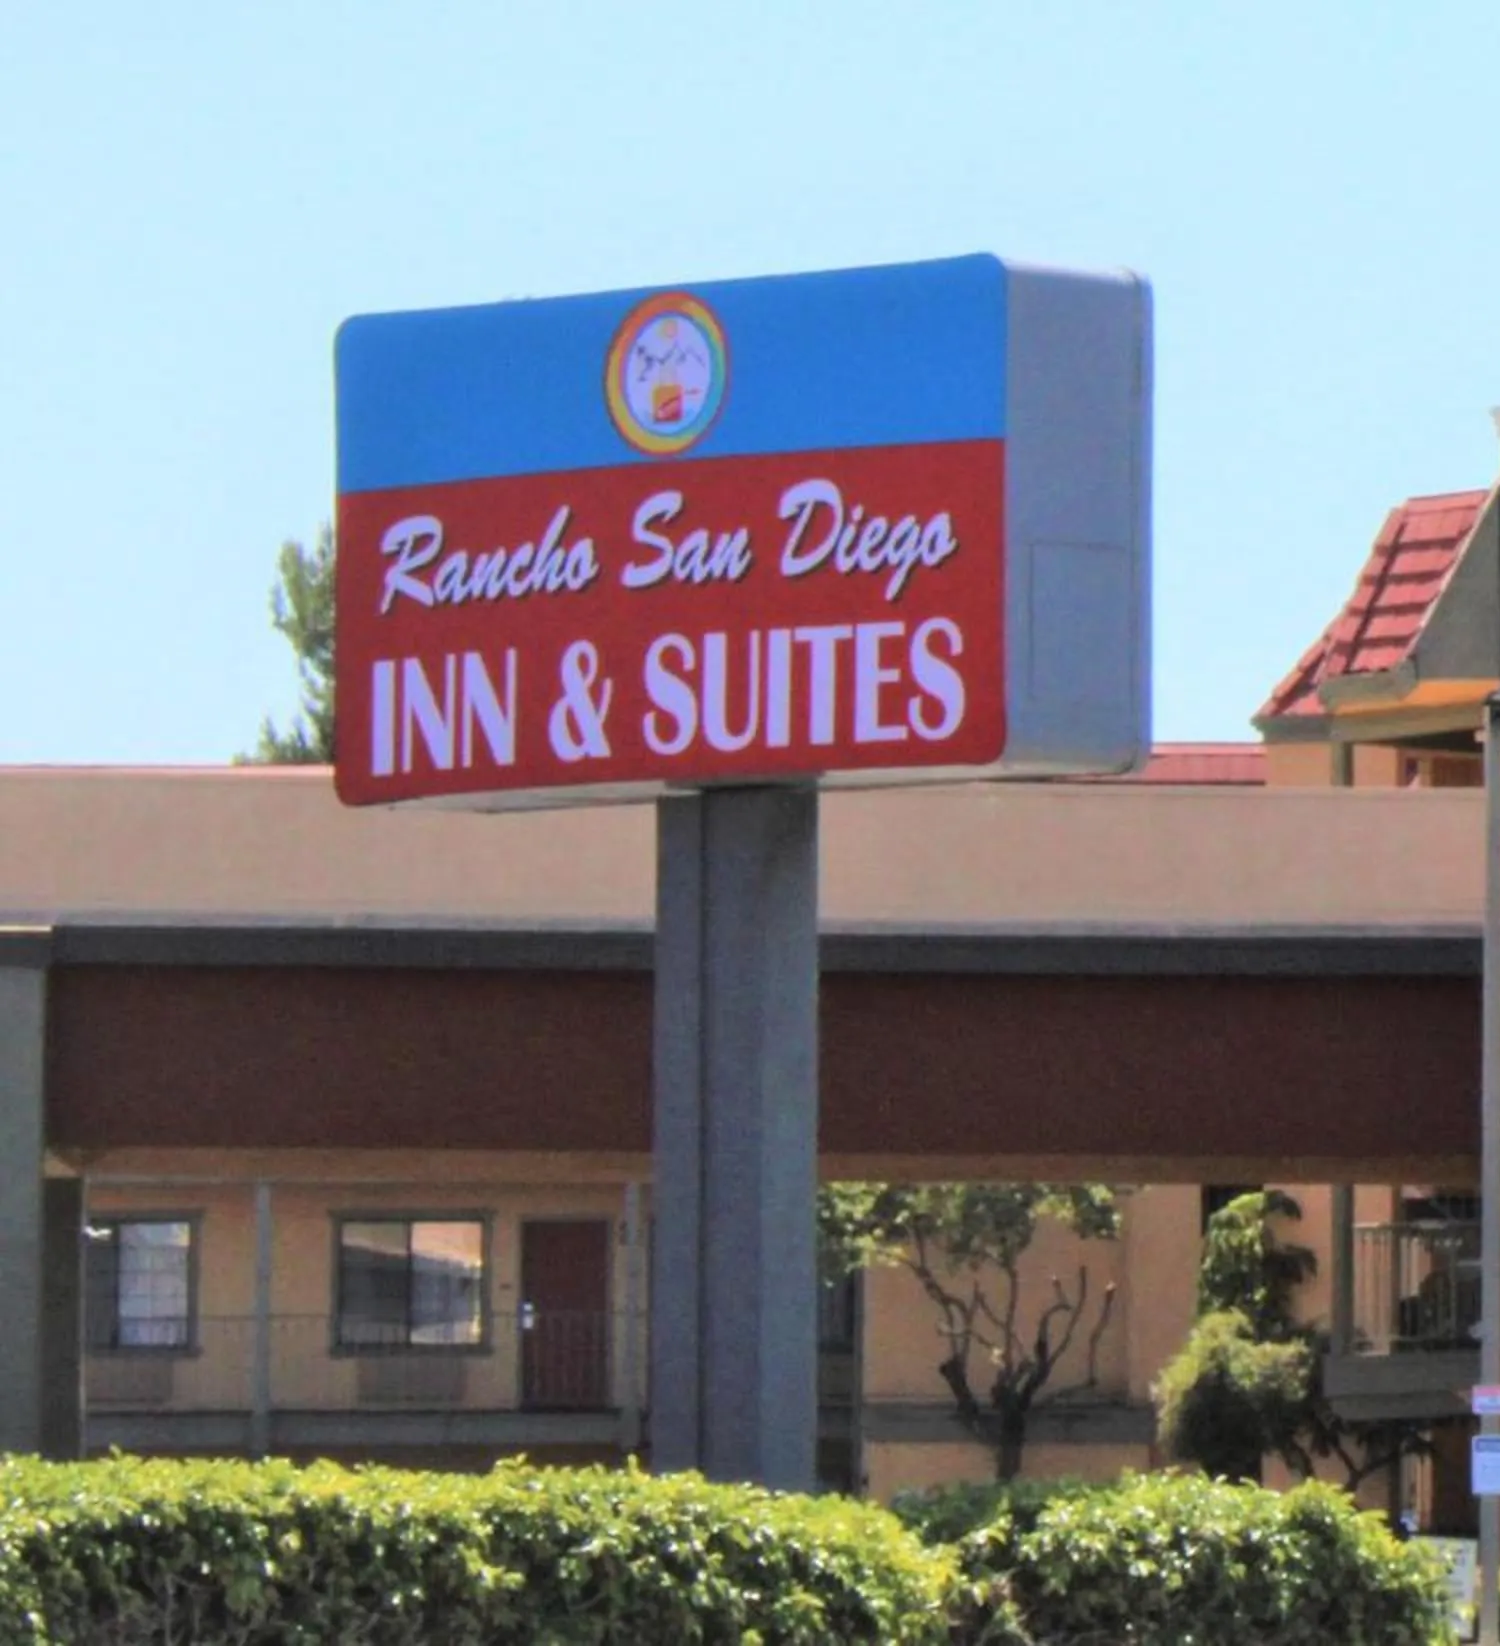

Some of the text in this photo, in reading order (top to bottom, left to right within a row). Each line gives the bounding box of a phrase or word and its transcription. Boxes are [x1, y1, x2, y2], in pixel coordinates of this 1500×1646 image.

[379, 478, 957, 615] Rancho San Diego
[371, 616, 967, 777] INN & SUITES
